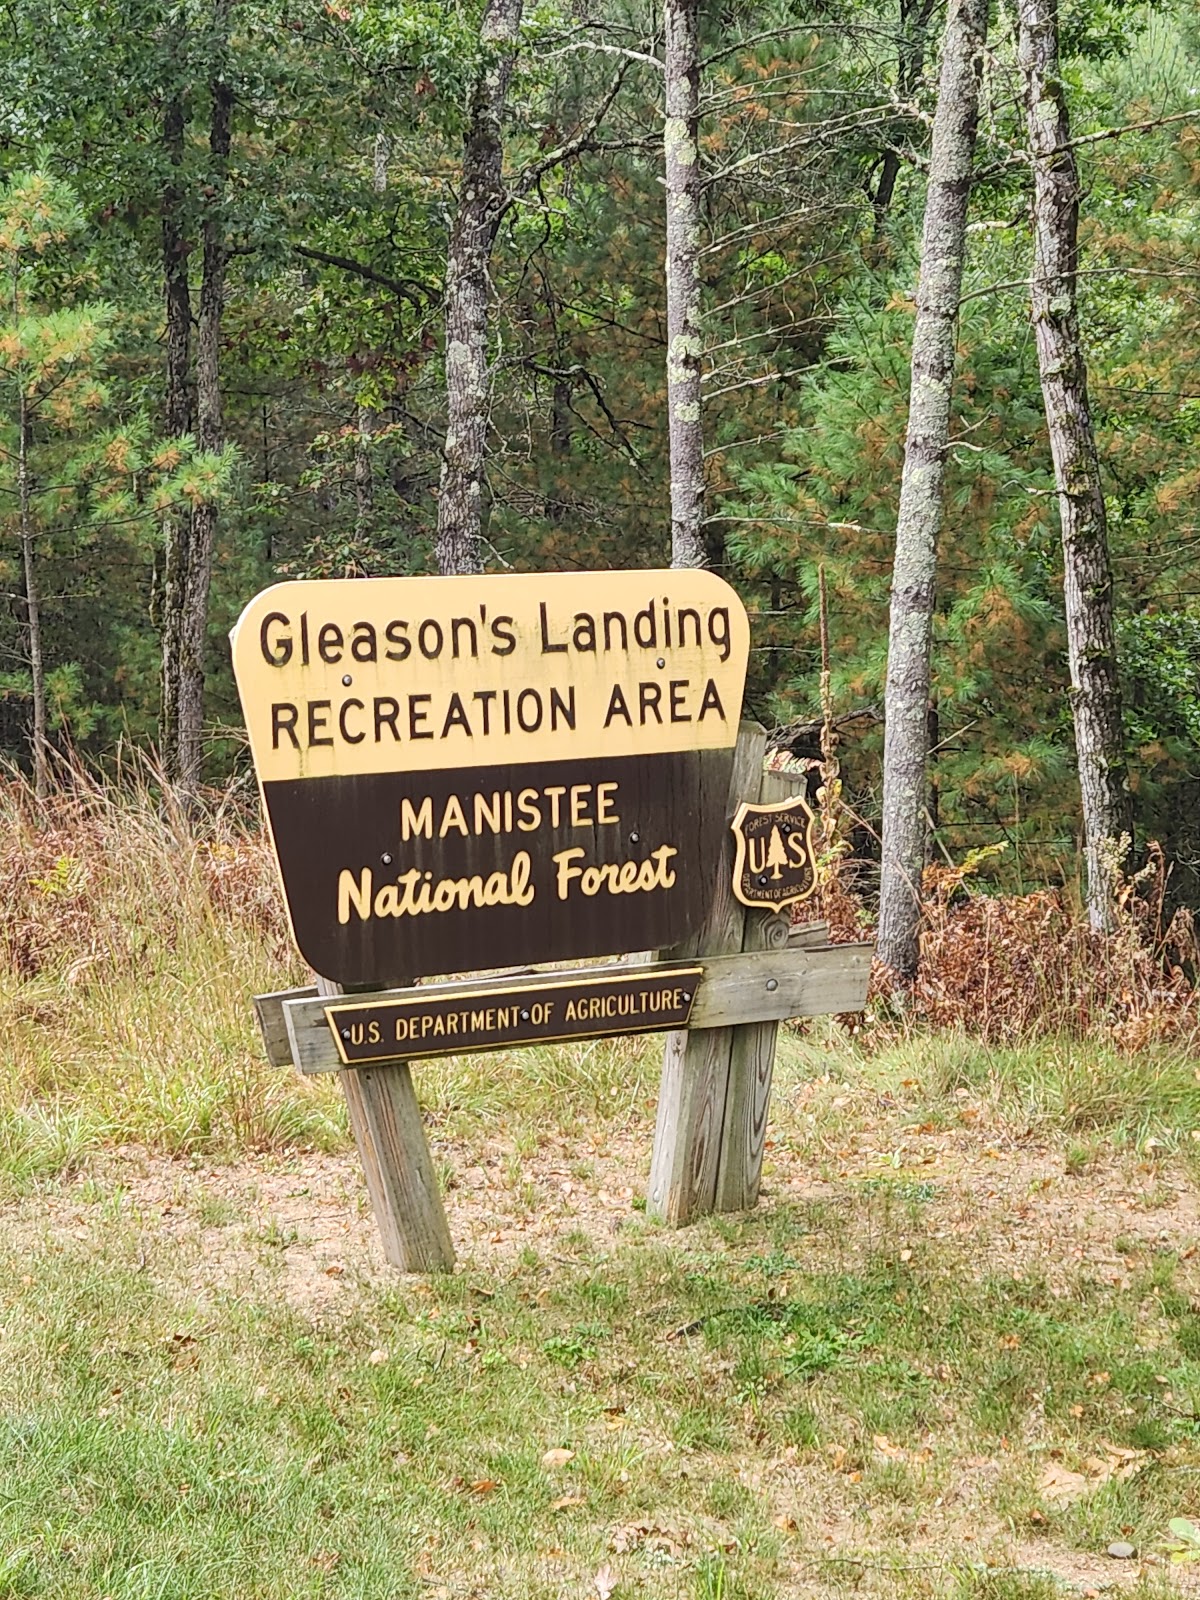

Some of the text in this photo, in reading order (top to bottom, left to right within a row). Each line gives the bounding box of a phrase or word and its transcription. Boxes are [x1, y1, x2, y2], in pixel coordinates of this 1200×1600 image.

[260, 597, 732, 667] Gleason's Landing
[271, 678, 726, 749] RECREATION AREA
[401, 782, 620, 841] MANISTEE
[338, 845, 678, 925] National Forest
[351, 987, 684, 1045] U.S. DEPARTMENT OF AGRICULTURE
